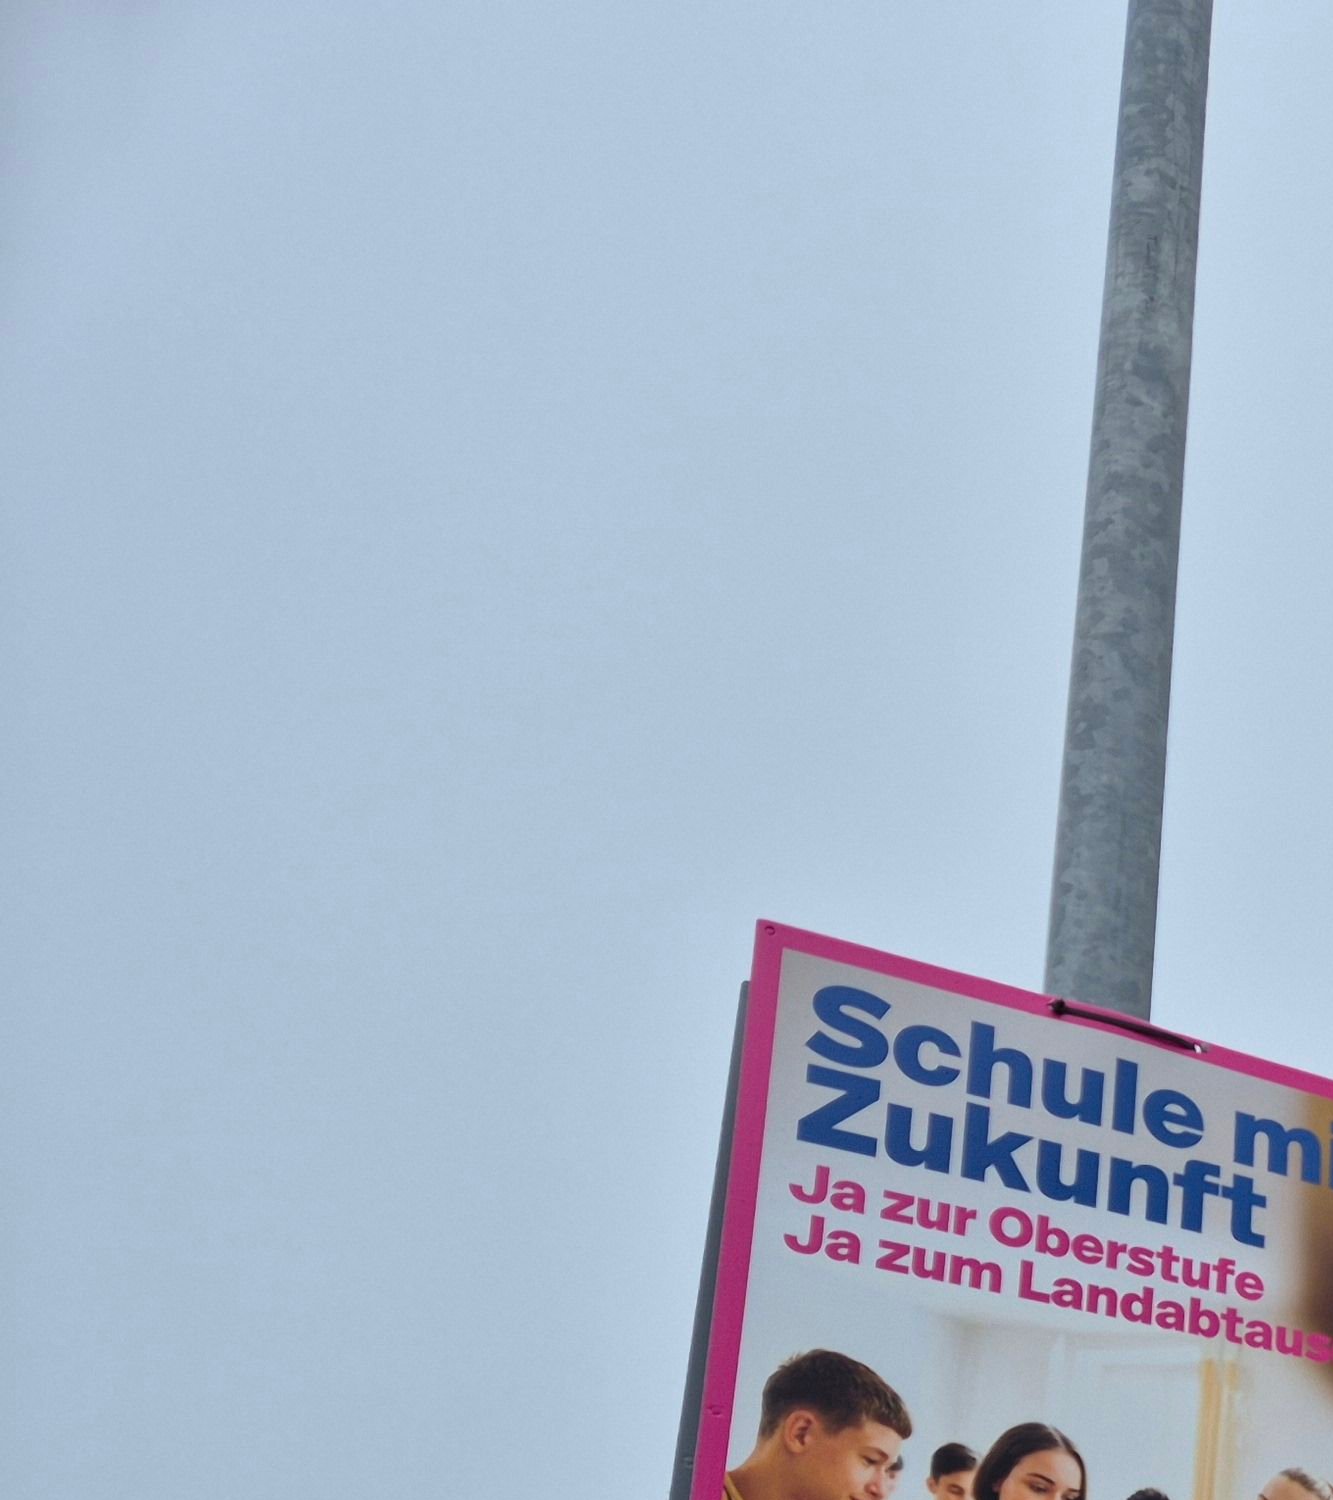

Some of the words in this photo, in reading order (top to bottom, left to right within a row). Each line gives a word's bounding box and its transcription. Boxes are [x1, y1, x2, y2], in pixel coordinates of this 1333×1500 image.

[805, 984, 1204, 1148] Schule
[797, 1063, 1267, 1248] Zukunft
[784, 1215, 860, 1264] Ja
[876, 1240, 1001, 1292] zum
[790, 1164, 866, 1214] Ja
[882, 1189, 977, 1238] zur
[988, 1205, 1265, 1301] Oberstufe
